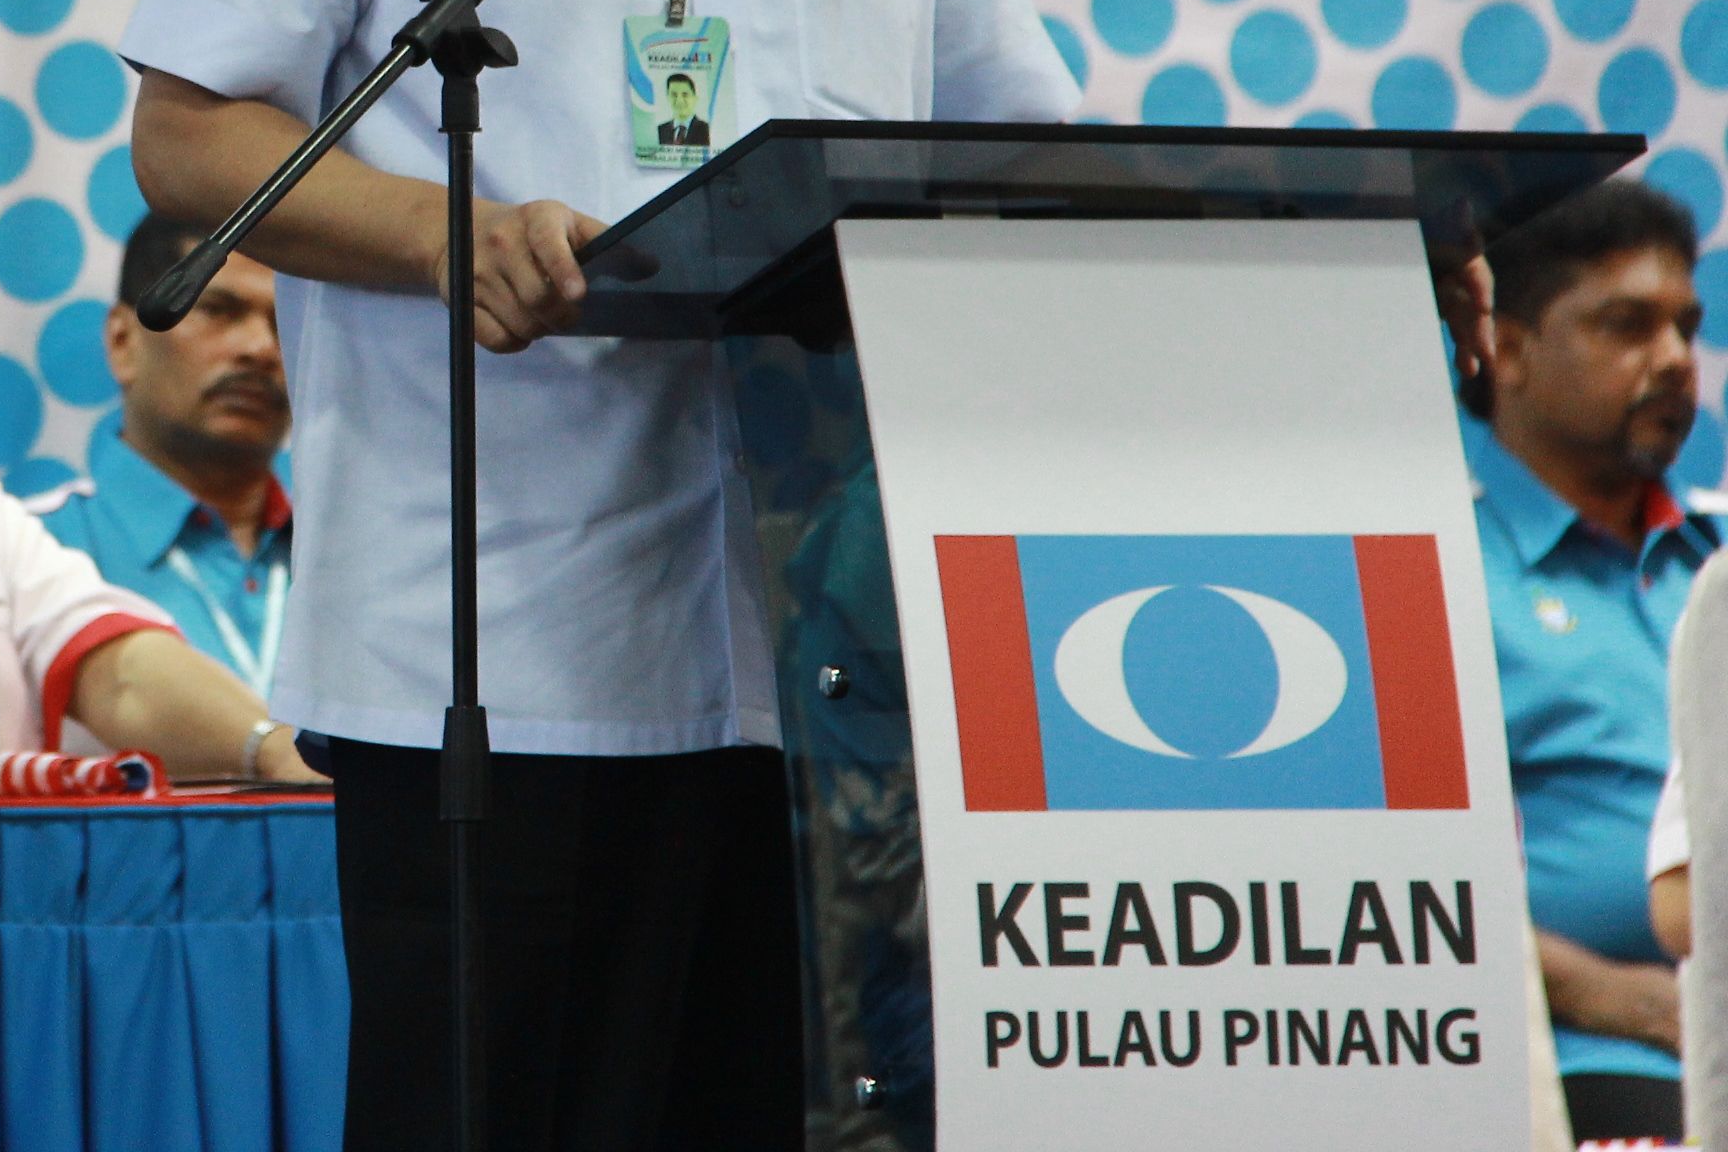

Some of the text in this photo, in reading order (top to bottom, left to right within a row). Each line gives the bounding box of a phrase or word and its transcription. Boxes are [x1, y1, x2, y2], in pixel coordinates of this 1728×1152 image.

[976, 881, 1477, 968] KEADILAN
[985, 1008, 1482, 1069] PULAU PINANG
